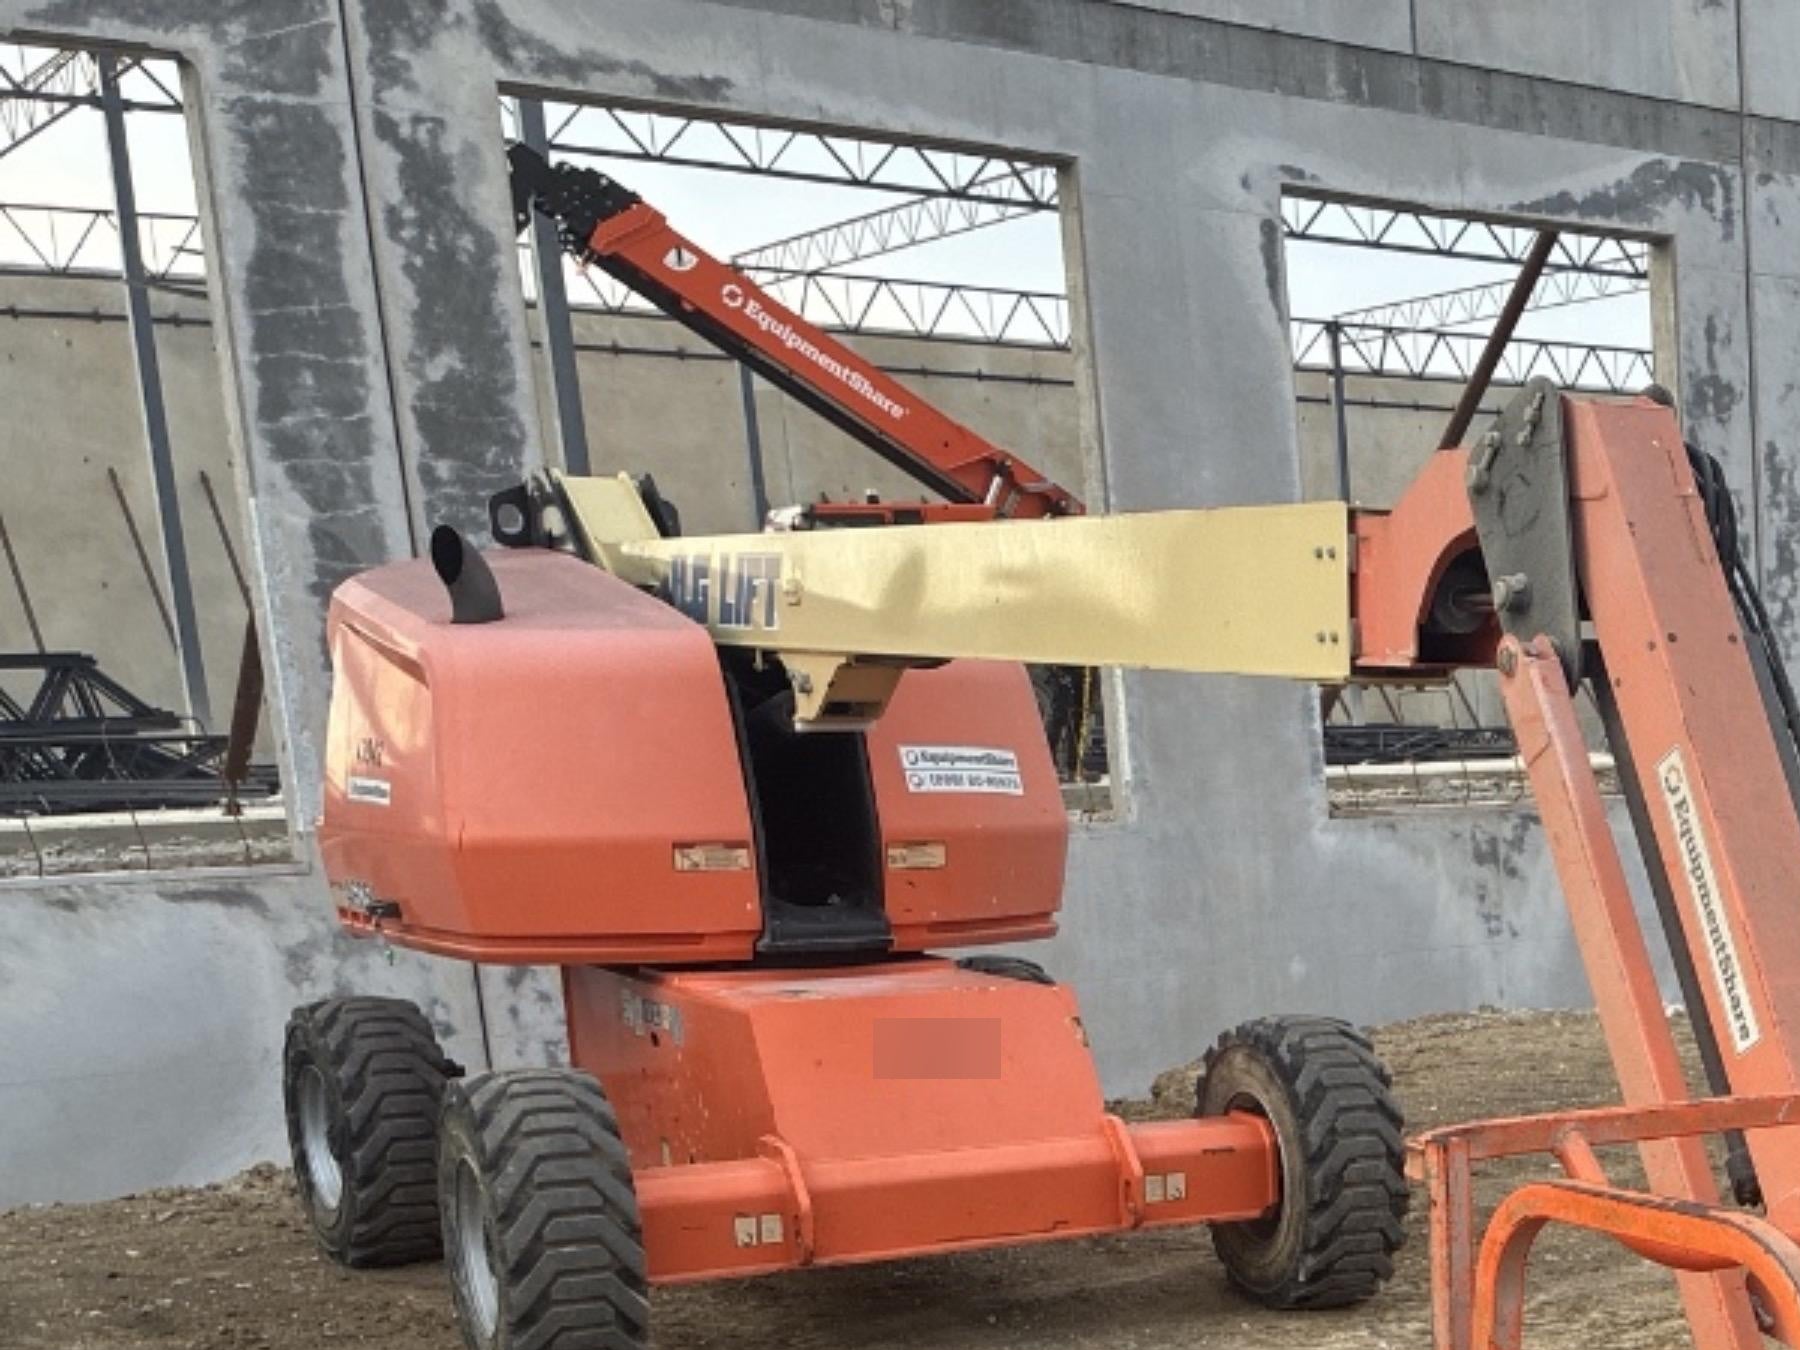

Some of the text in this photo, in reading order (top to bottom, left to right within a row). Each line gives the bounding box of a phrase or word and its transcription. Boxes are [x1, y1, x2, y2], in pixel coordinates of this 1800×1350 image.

[743, 298, 904, 418] EquipmentShare
[718, 554, 782, 632] LIFT
[1672, 798, 1750, 1042] EquipmentShare
